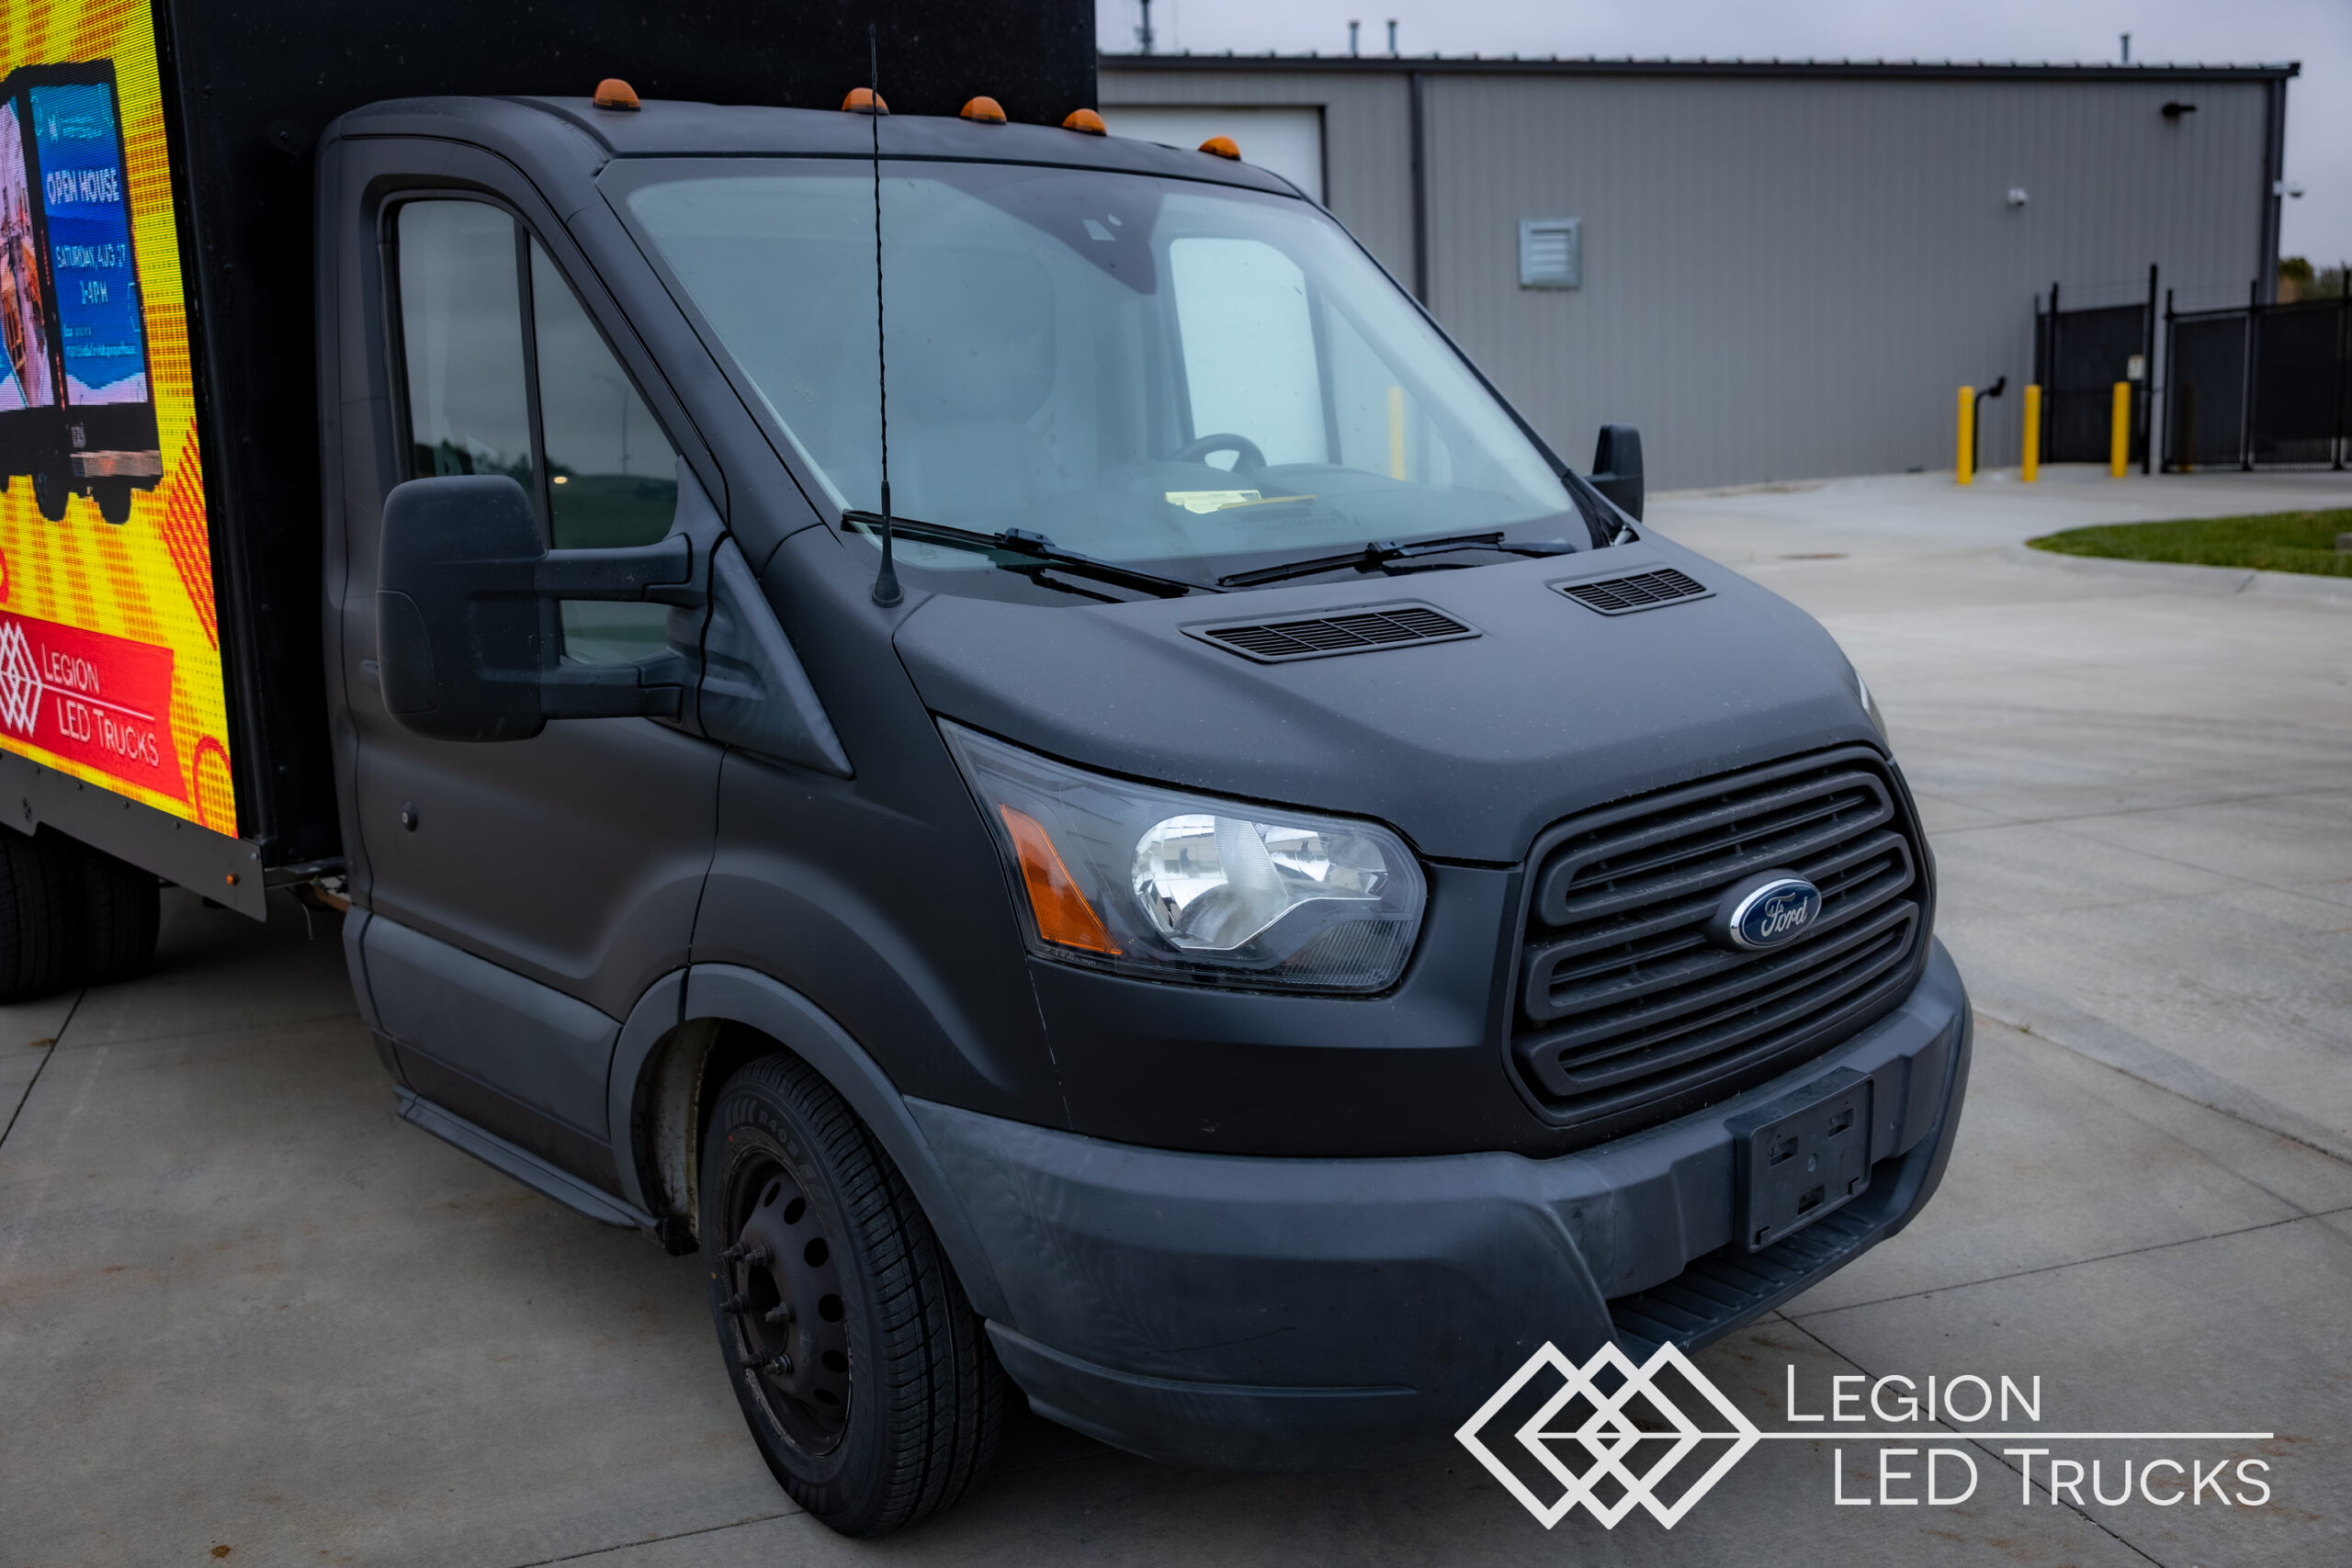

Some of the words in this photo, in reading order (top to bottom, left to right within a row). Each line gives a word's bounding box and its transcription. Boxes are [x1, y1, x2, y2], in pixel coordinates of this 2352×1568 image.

[47, 169, 78, 205] OPEN
[79, 167, 120, 203] HOUSE
[41, 643, 99, 694] LEGION
[57, 696, 91, 742] LED
[93, 707, 159, 767] TRUCKS
[1760, 891, 1809, 937] Ford
